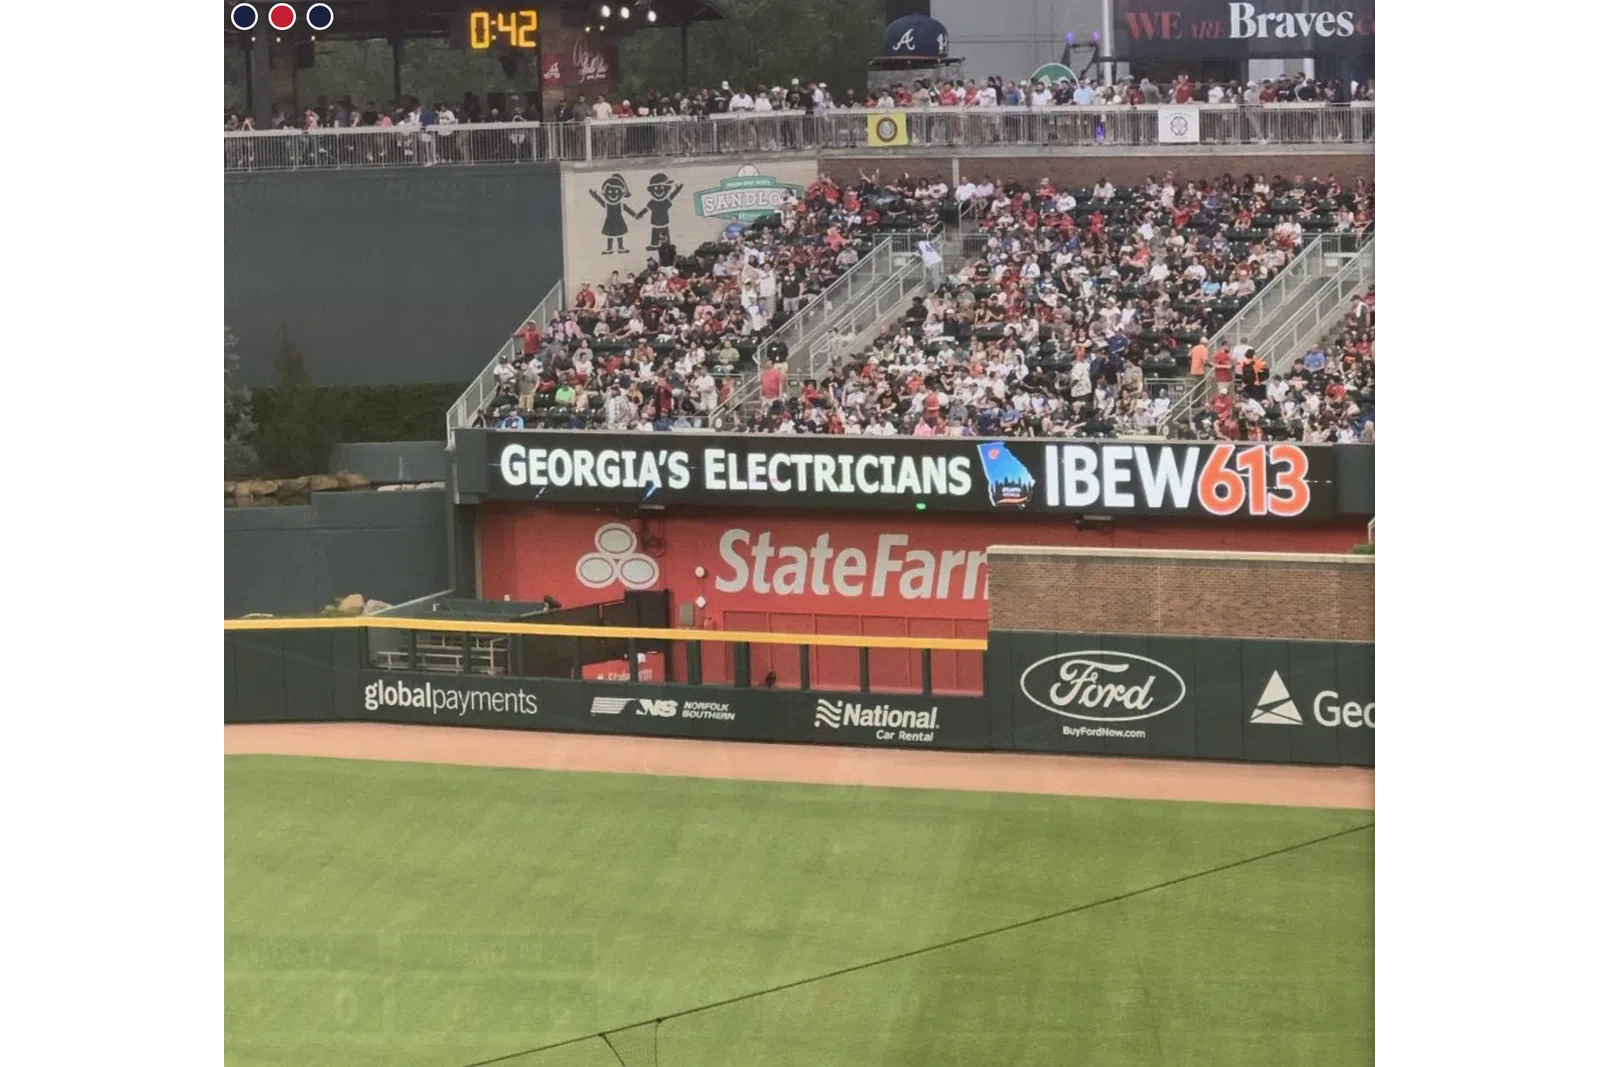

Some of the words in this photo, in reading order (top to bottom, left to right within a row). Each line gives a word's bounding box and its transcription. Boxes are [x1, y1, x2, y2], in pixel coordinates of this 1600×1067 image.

[470, 10, 538, 49] 0:42
[1126, 11, 1183, 40] WE
[1228, 2, 1355, 38] Braves
[704, 191, 787, 214] SANDLO
[704, 448, 972, 496] ELECTRICIANS
[1050, 659, 1157, 710] Ford
[682, 710, 736, 720] SOUTHERN
[683, 701, 730, 711] NORFOLK
[842, 702, 940, 730] National
[875, 729, 896, 741] Car
[898, 731, 935, 742] Rental
[1062, 725, 1146, 739] BuyFordNow.com
